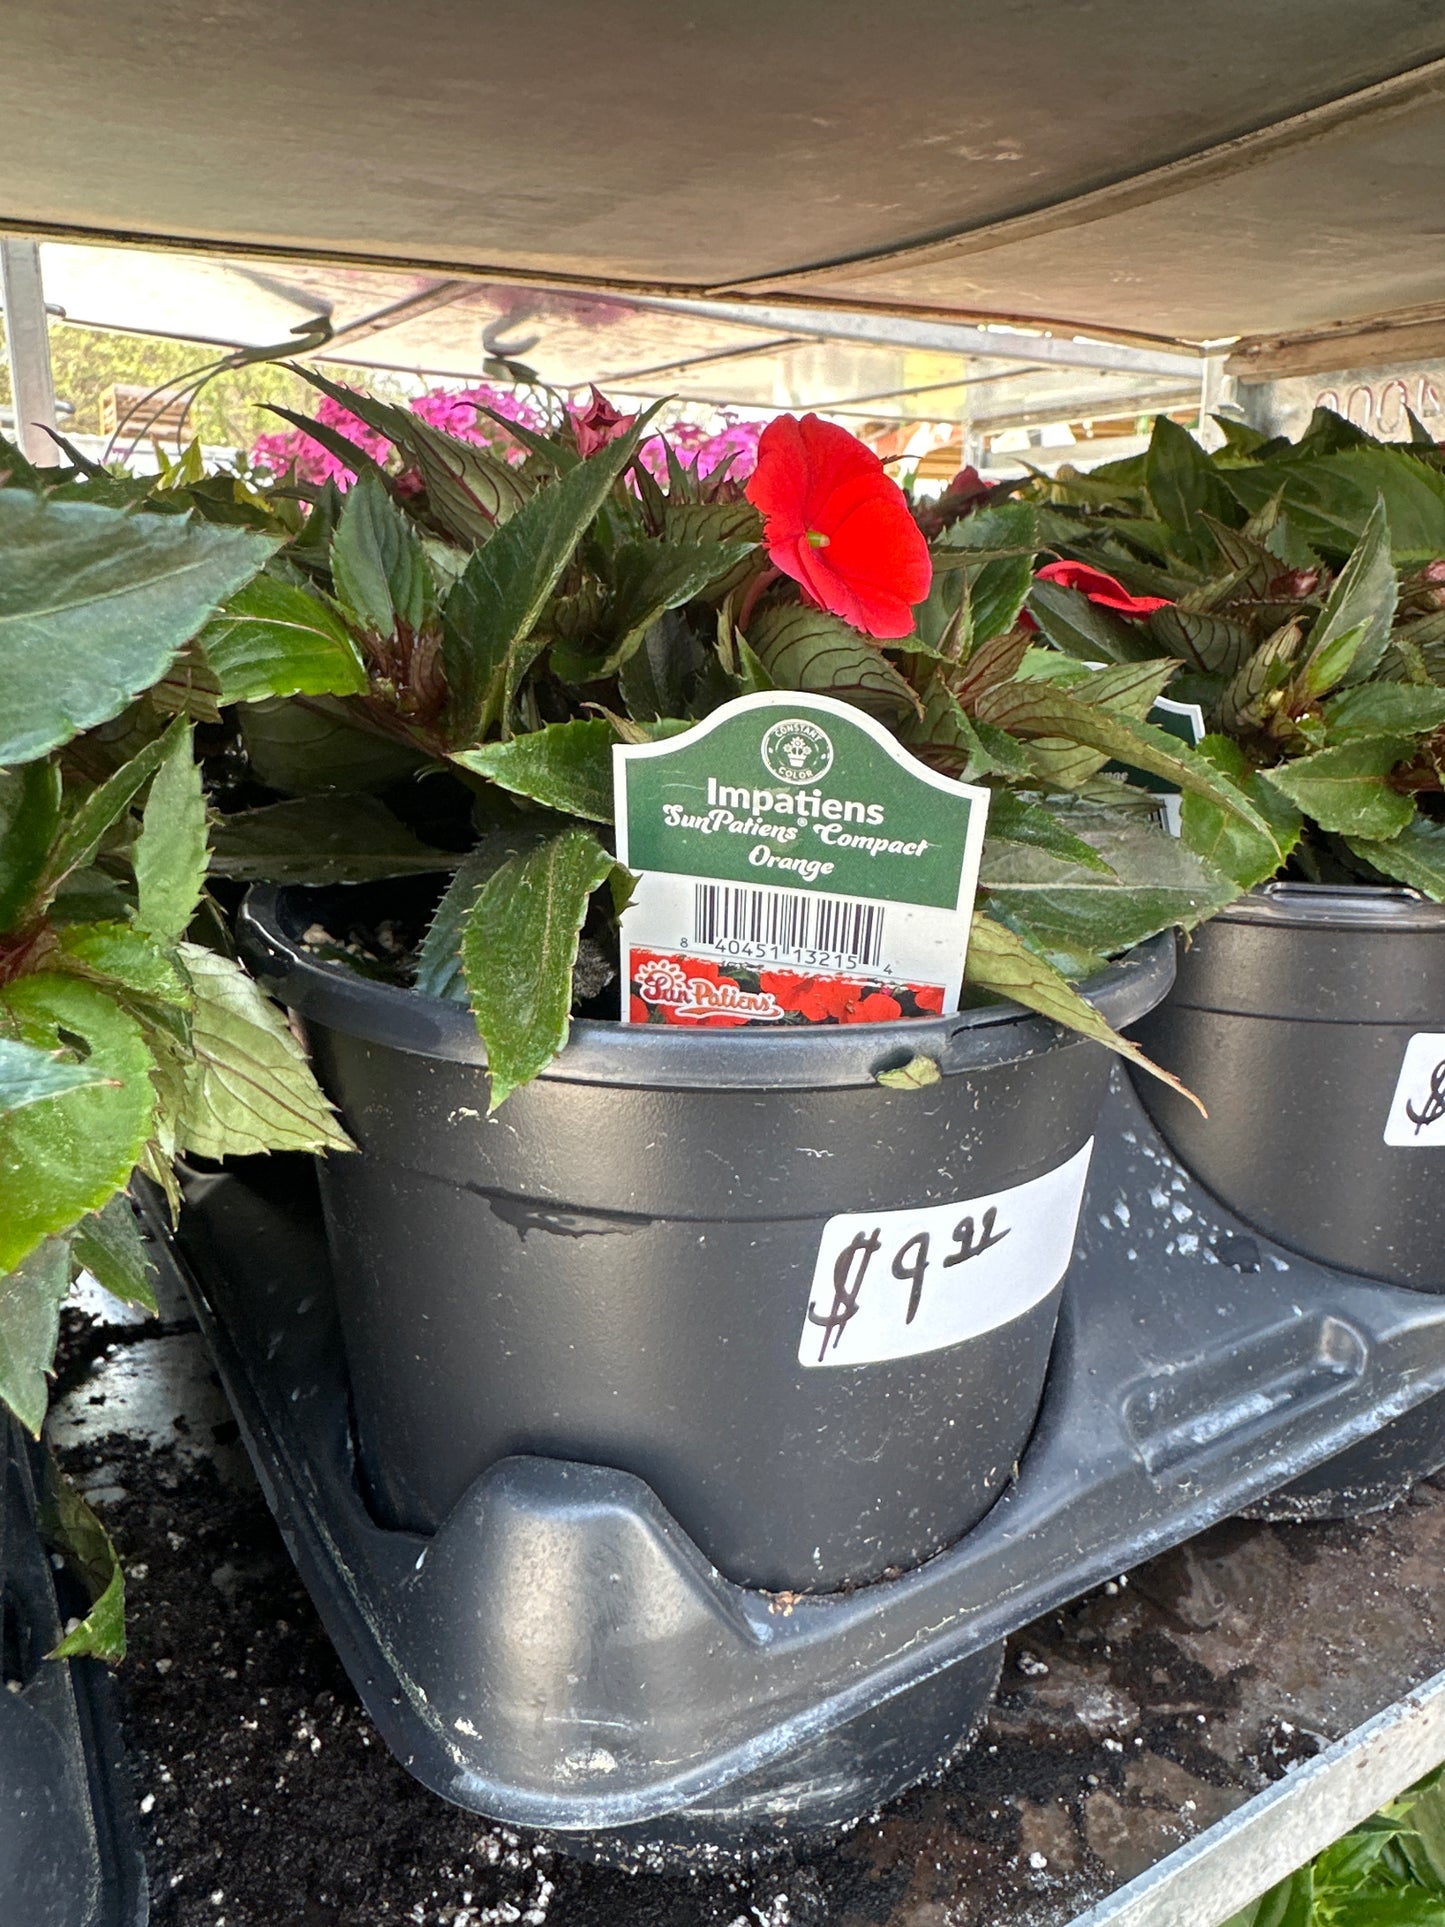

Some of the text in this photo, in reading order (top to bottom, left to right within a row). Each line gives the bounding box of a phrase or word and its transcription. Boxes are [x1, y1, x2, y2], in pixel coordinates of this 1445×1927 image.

[775, 723, 822, 741] CONSTANT
[778, 766, 813, 779] COLOR
[707, 777, 884, 825] Impatiens
[812, 823, 928, 857] Compact
[748, 845, 835, 882] Orange
[680, 937, 893, 975] 8 40451 13215 4
